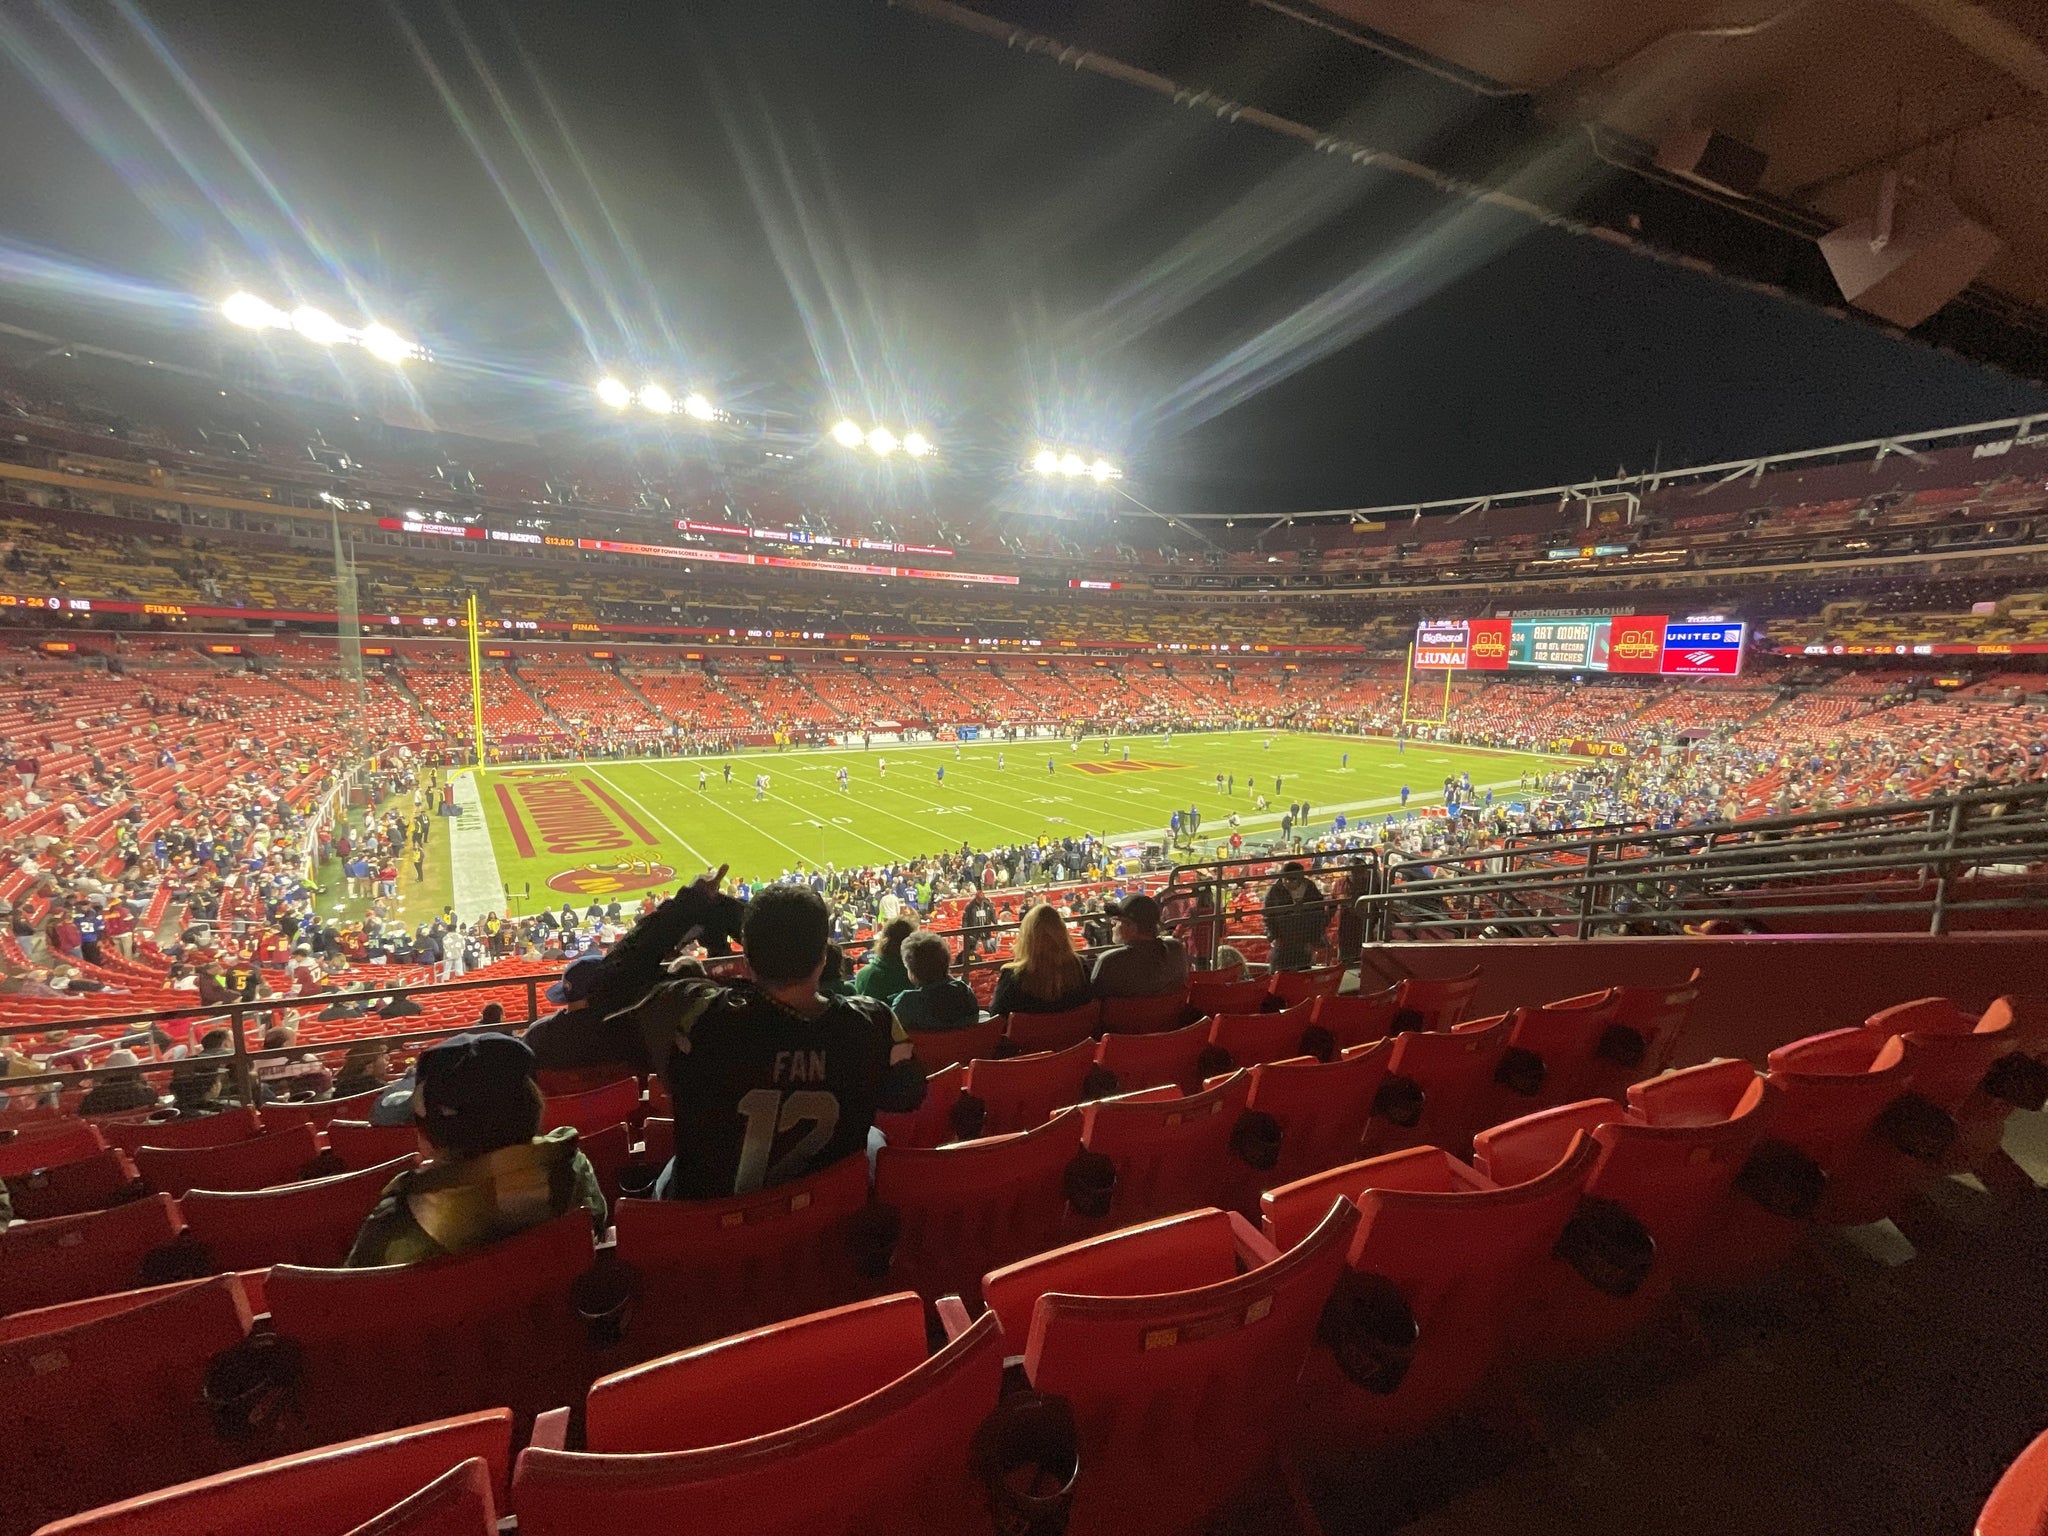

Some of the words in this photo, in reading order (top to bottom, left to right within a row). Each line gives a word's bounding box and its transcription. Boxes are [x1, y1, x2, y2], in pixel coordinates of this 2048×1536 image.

[27, 597, 44, 607] 24
[70, 600, 90, 610] NE
[144, 605, 186, 614] FINAL
[1512, 608, 1578, 618] NORTHWEST
[1580, 606, 1635, 617] STADIUM
[572, 623, 600, 631] FINAL
[1534, 626, 1553, 640] ART
[1557, 626, 1589, 640] MONK
[1667, 633, 1721, 641] UNITED
[1475, 632, 1502, 657] 81
[1620, 631, 1654, 658] 81
[1804, 645, 1827, 654] ATL
[1977, 645, 2011, 654] FINAL
[1417, 652, 1465, 665] LiUNA!
[1550, 653, 1583, 662] CATCHES
[236, 976, 246, 990] 5
[774, 1050, 827, 1083] FAN
[734, 1088, 840, 1195] 12
